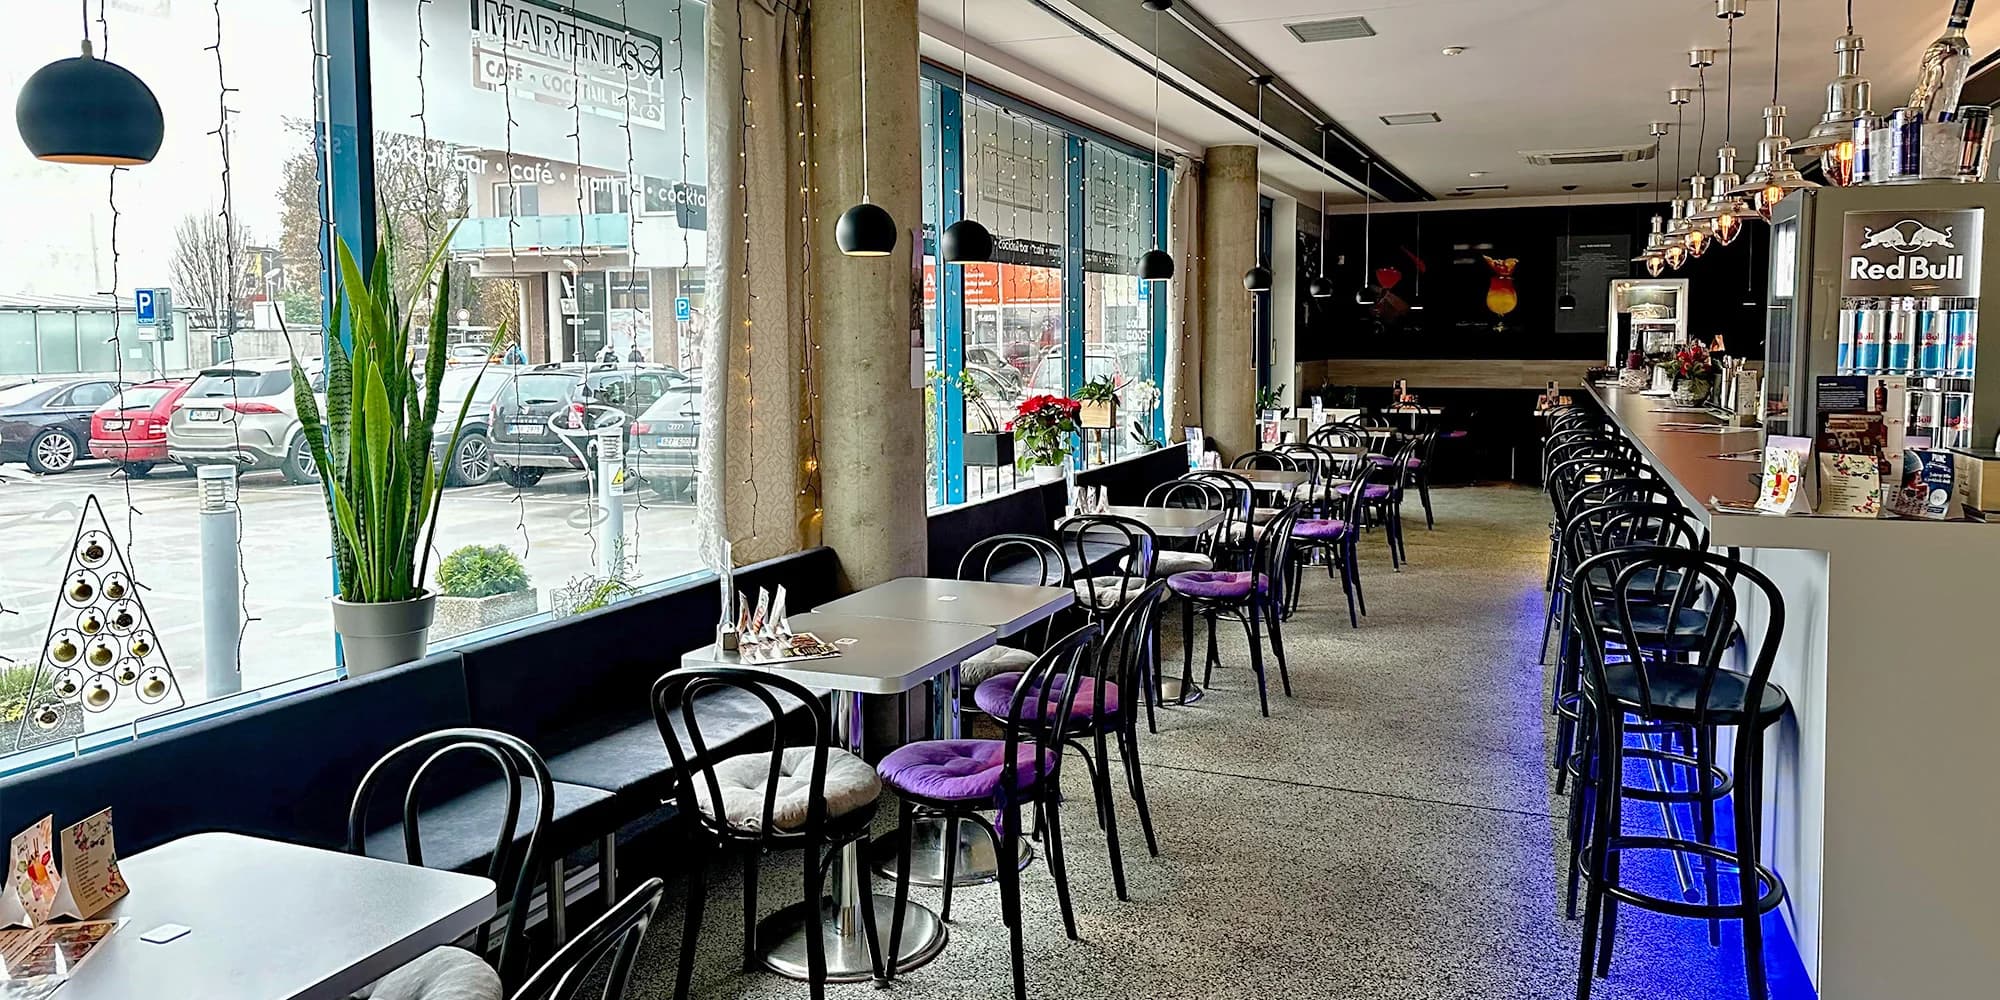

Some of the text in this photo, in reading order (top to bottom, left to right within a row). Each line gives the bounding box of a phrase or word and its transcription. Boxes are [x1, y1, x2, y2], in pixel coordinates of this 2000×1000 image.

[484, 1, 641, 79] MARTINI'S
[485, 60, 523, 81] CAFÉ
[542, 73, 608, 104] COCTAIL
[511, 162, 554, 185] café
[1850, 255, 1963, 280] Red Bull
[139, 292, 151, 314] P
[678, 300, 687, 315] P
